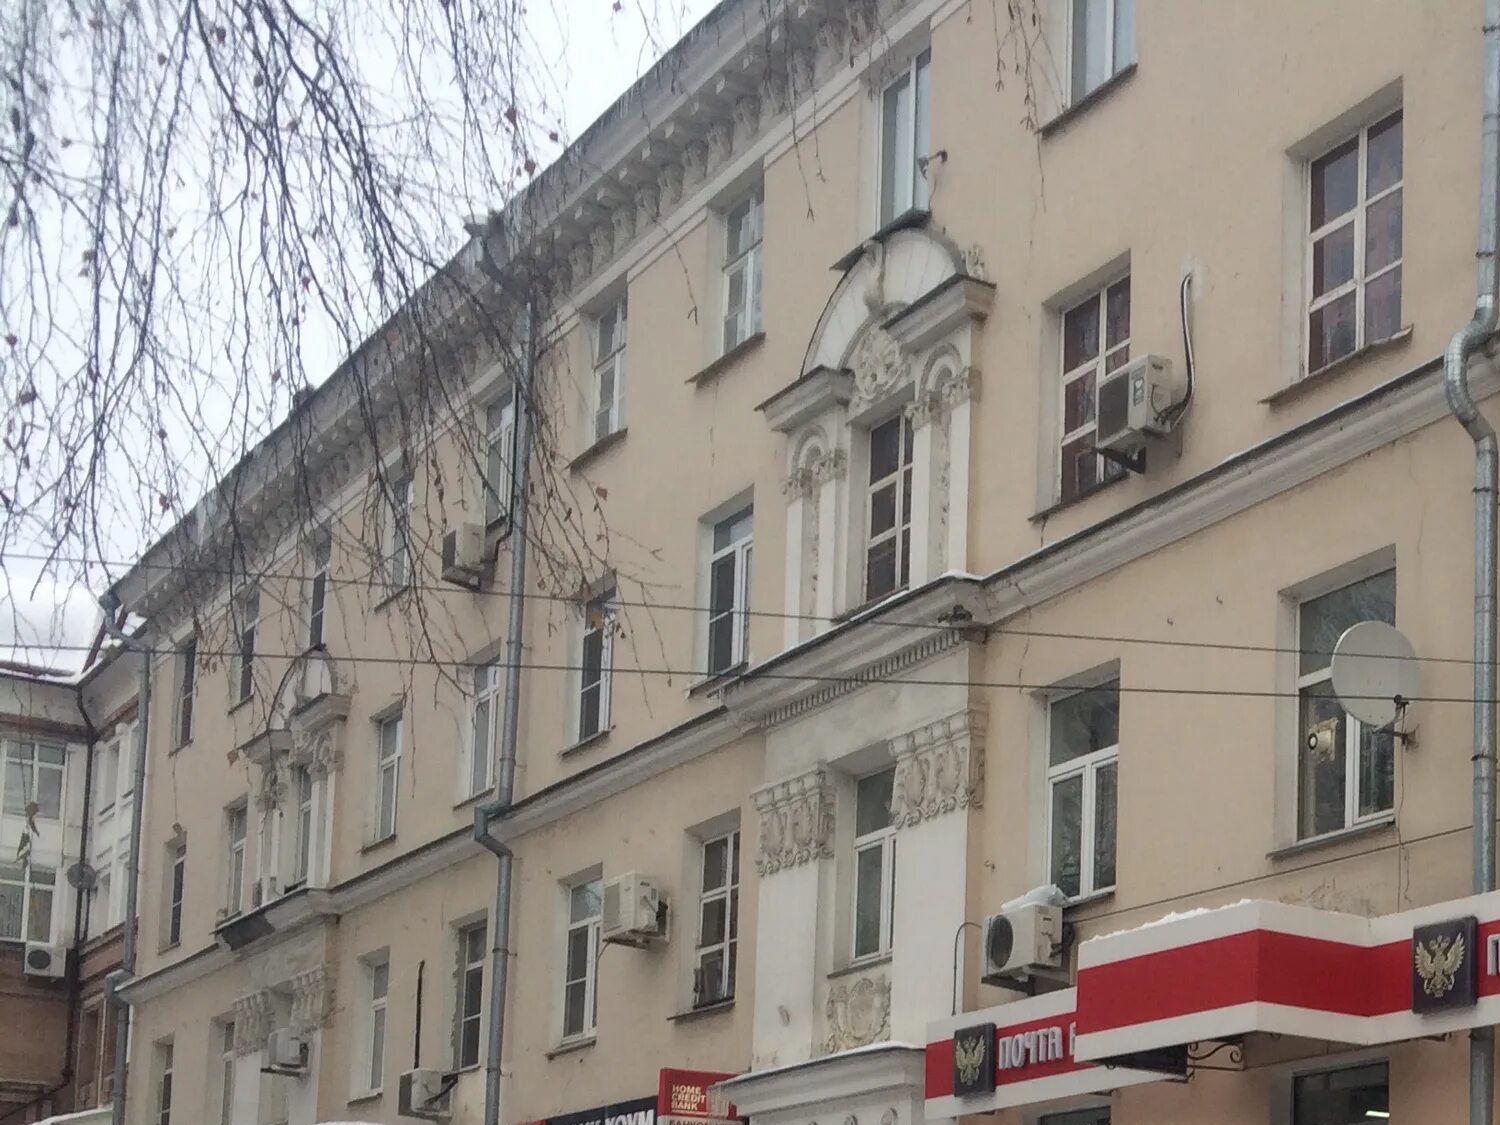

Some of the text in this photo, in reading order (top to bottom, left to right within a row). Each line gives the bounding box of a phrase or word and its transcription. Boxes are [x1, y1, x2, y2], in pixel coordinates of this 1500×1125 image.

[999, 1026, 1063, 1070] ПОЧТА
[672, 1084, 702, 1098] HOME
[671, 1094, 707, 1110] CREDIT
[671, 1101, 699, 1111] BANK
